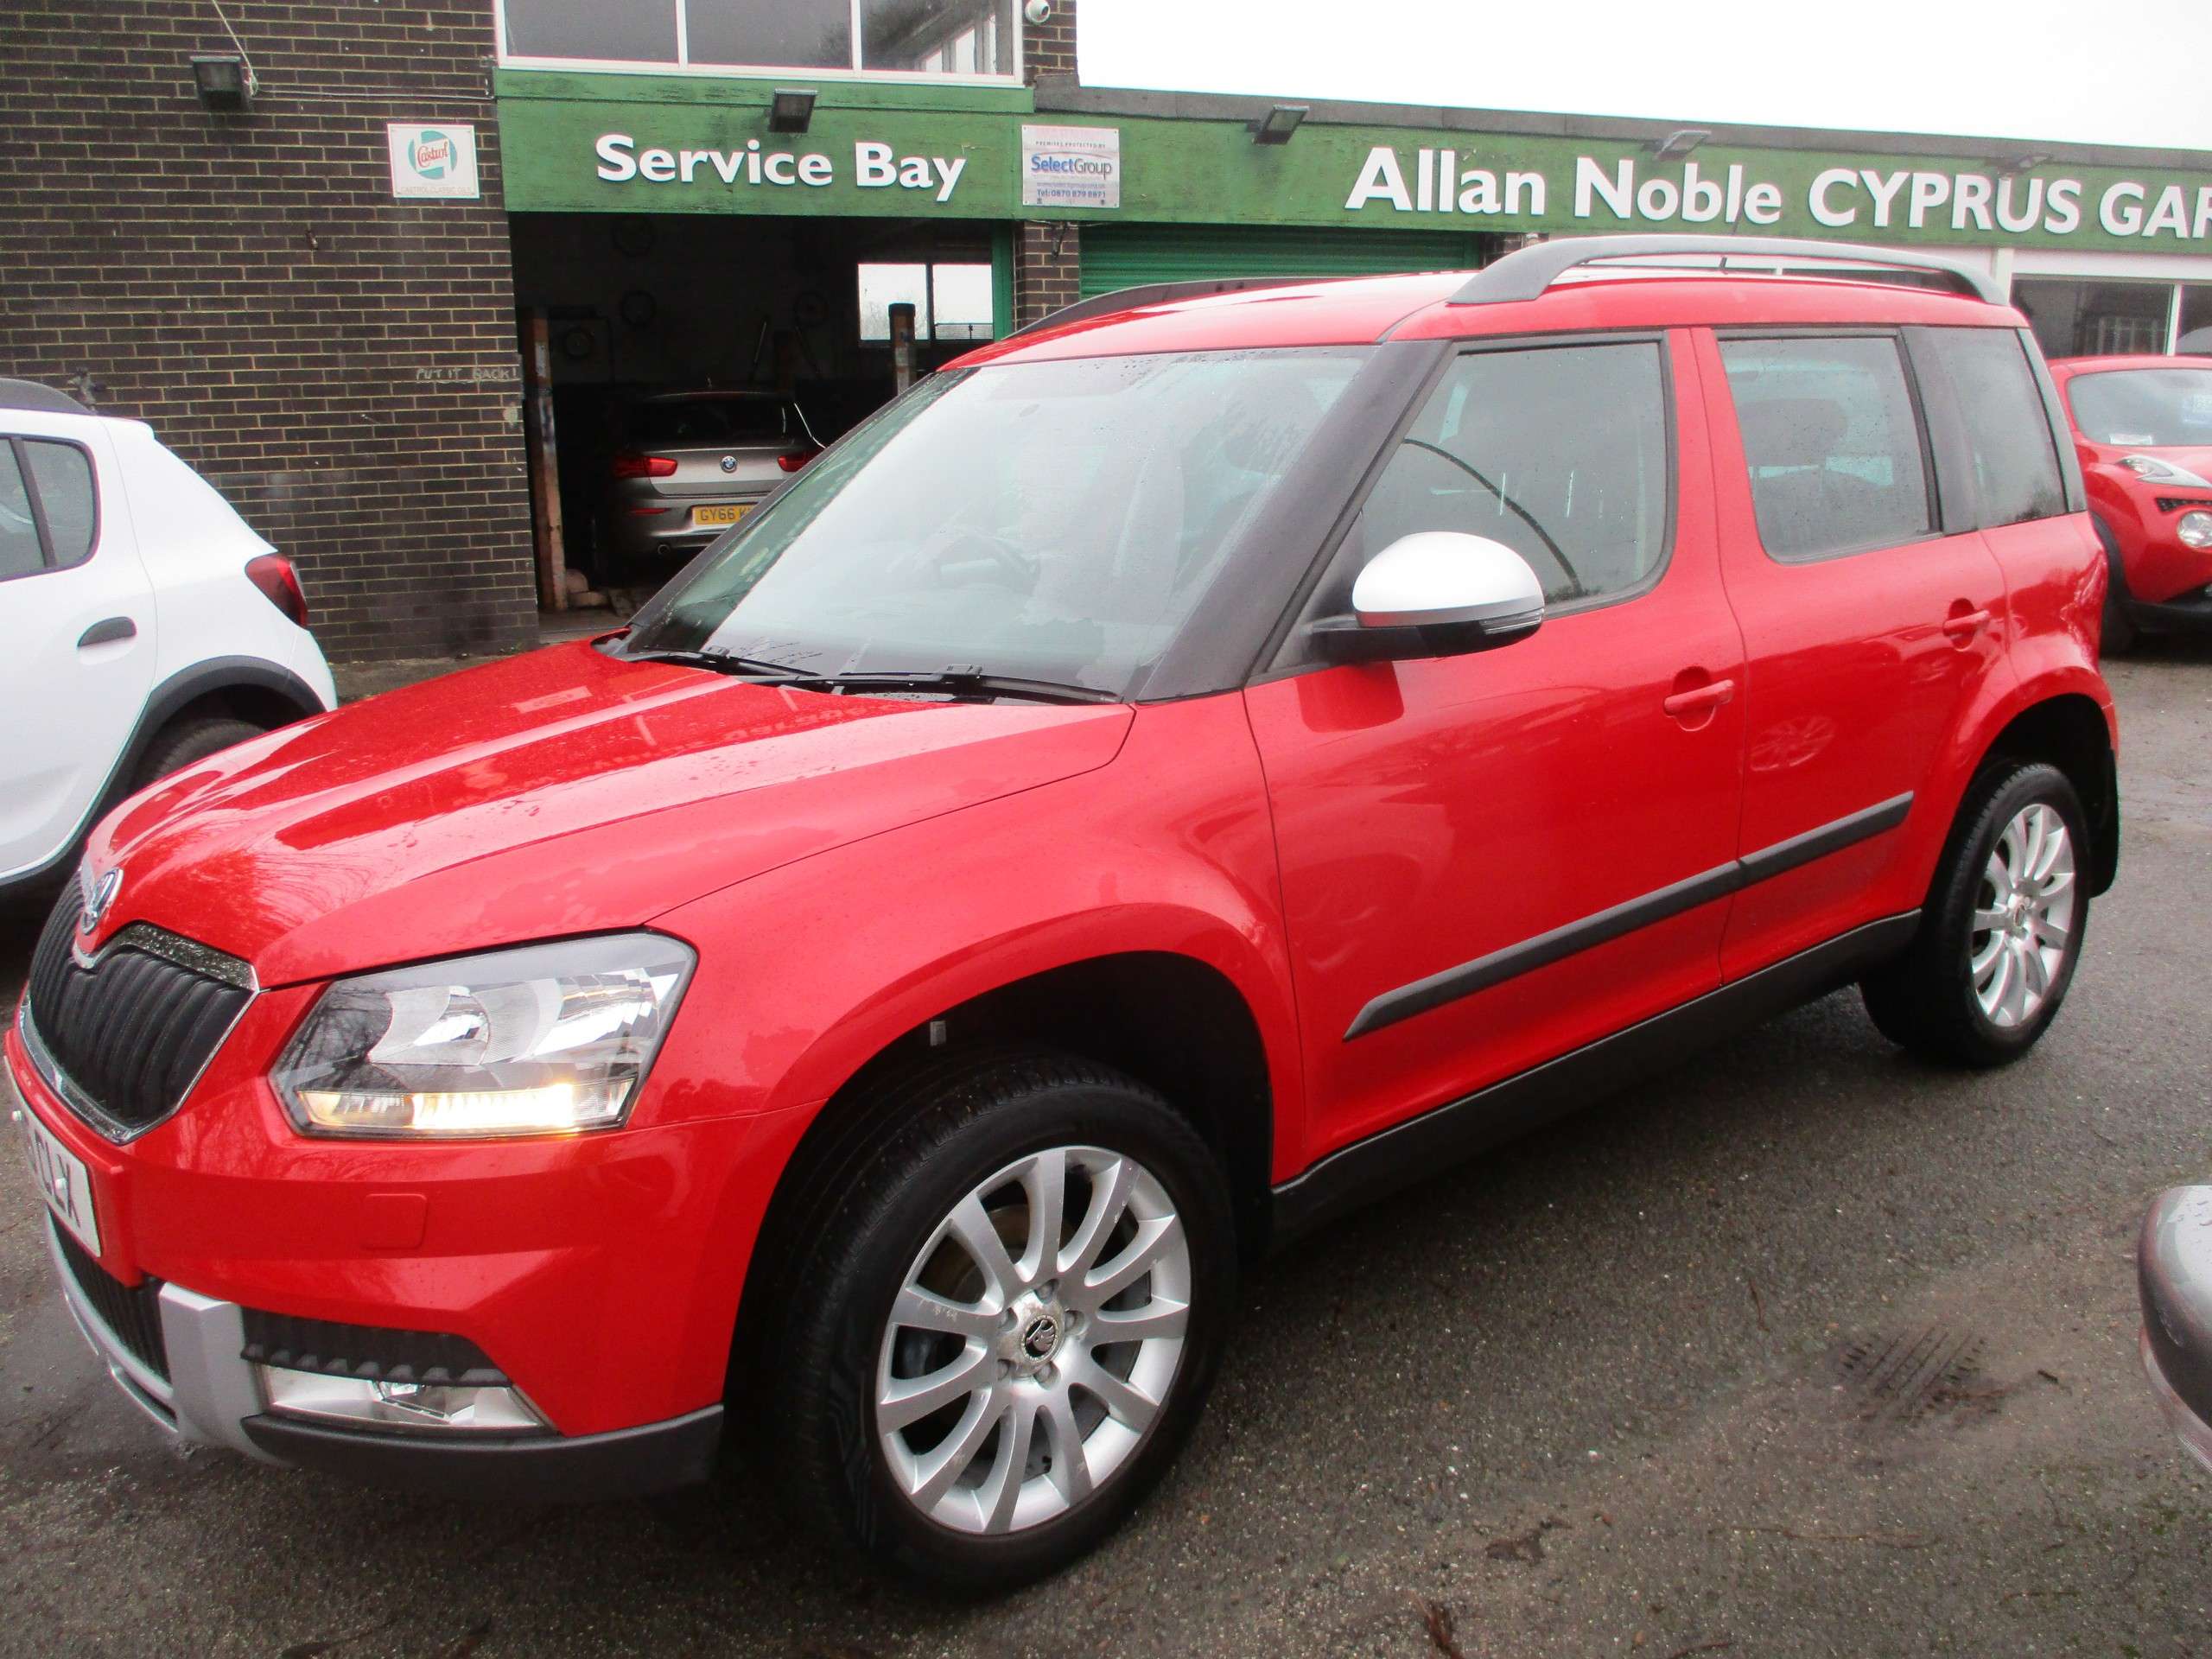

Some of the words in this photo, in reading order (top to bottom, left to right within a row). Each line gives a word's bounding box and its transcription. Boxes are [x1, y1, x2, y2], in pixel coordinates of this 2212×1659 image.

[595, 134, 834, 186] Service
[854, 141, 967, 201] Bay
[1031, 155, 1112, 180] SelectGroup
[1344, 146, 1546, 216] Allan
[1573, 156, 1783, 225] Noble
[1808, 168, 2082, 234] CYPRUS
[416, 367, 442, 380] PUT
[448, 367, 462, 379] IT
[473, 367, 518, 379] BACK!
[700, 508, 734, 520] GY66
